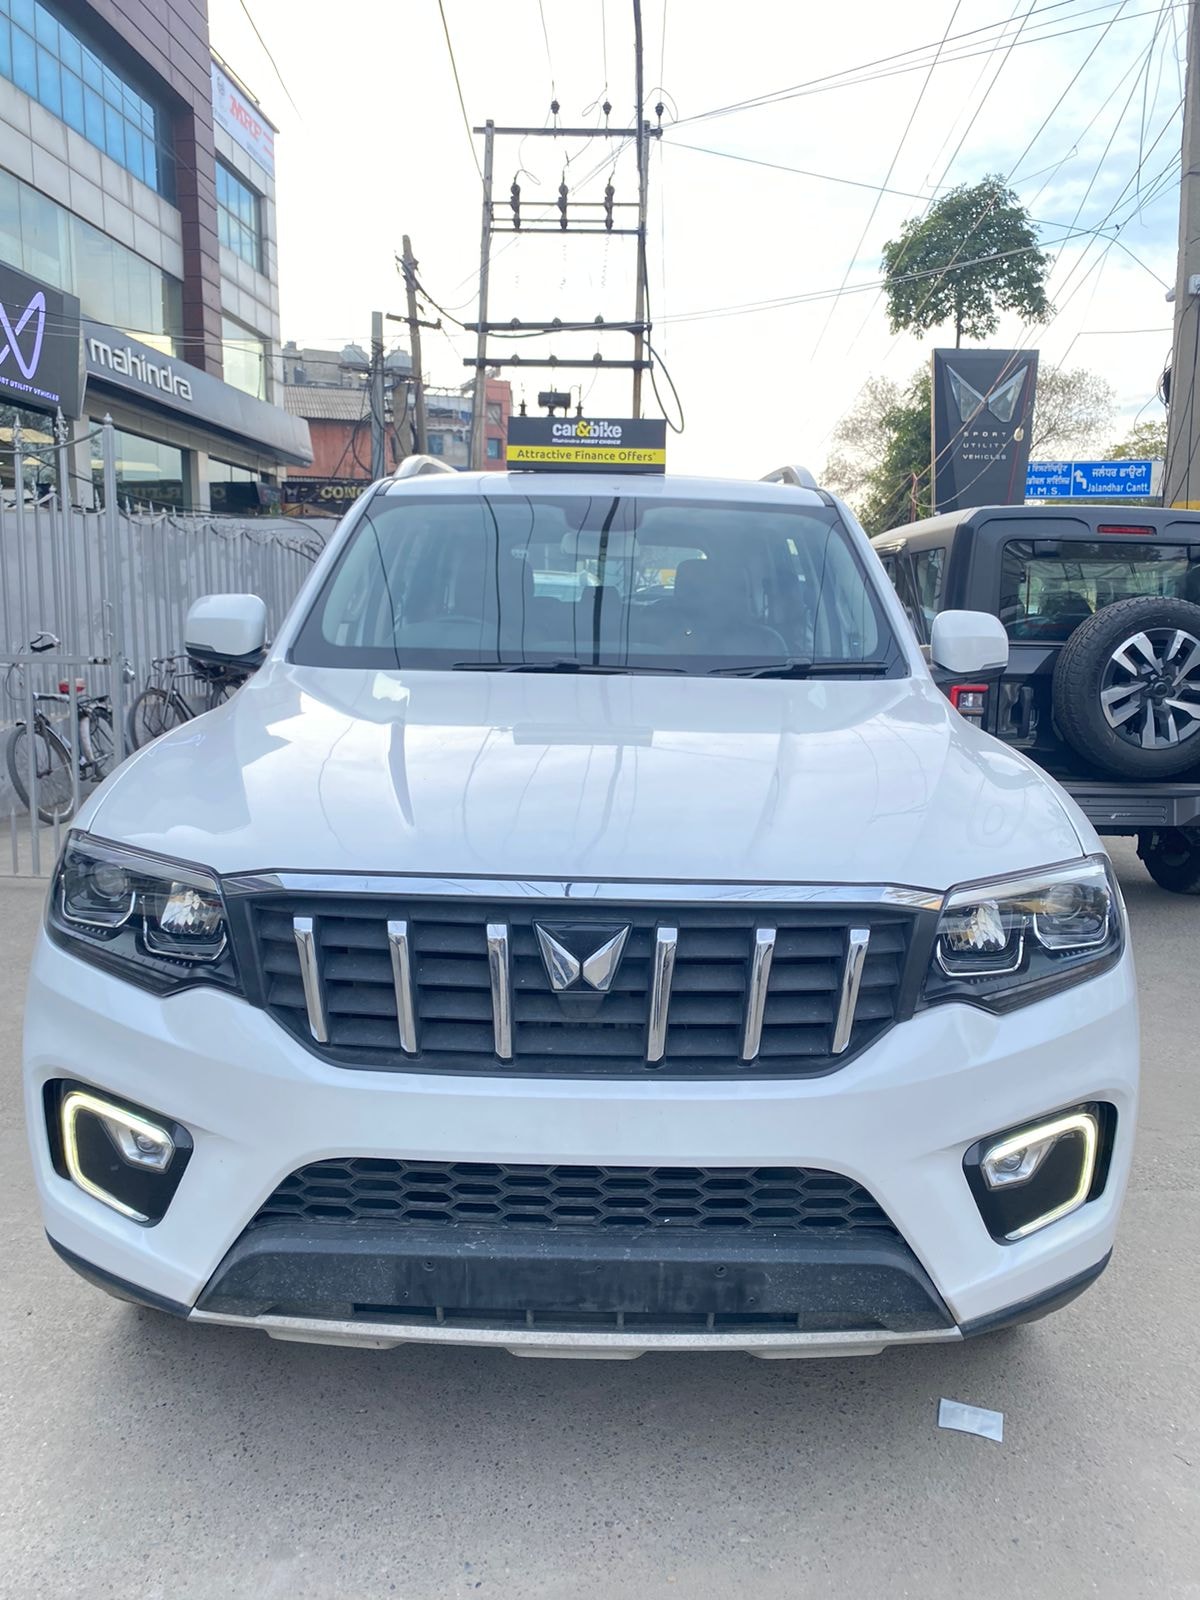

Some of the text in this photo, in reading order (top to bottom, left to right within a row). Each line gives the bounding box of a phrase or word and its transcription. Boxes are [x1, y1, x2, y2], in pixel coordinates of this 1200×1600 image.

[90, 338, 193, 401] mahindra
[10, 380, 33, 392] UTILITY
[33, 388, 60, 402] VEHICLES
[552, 420, 622, 438] car&bike
[517, 449, 572, 460] Attractive
[575, 450, 615, 461] Finance
[1087, 483, 1124, 492] Jalandhar
